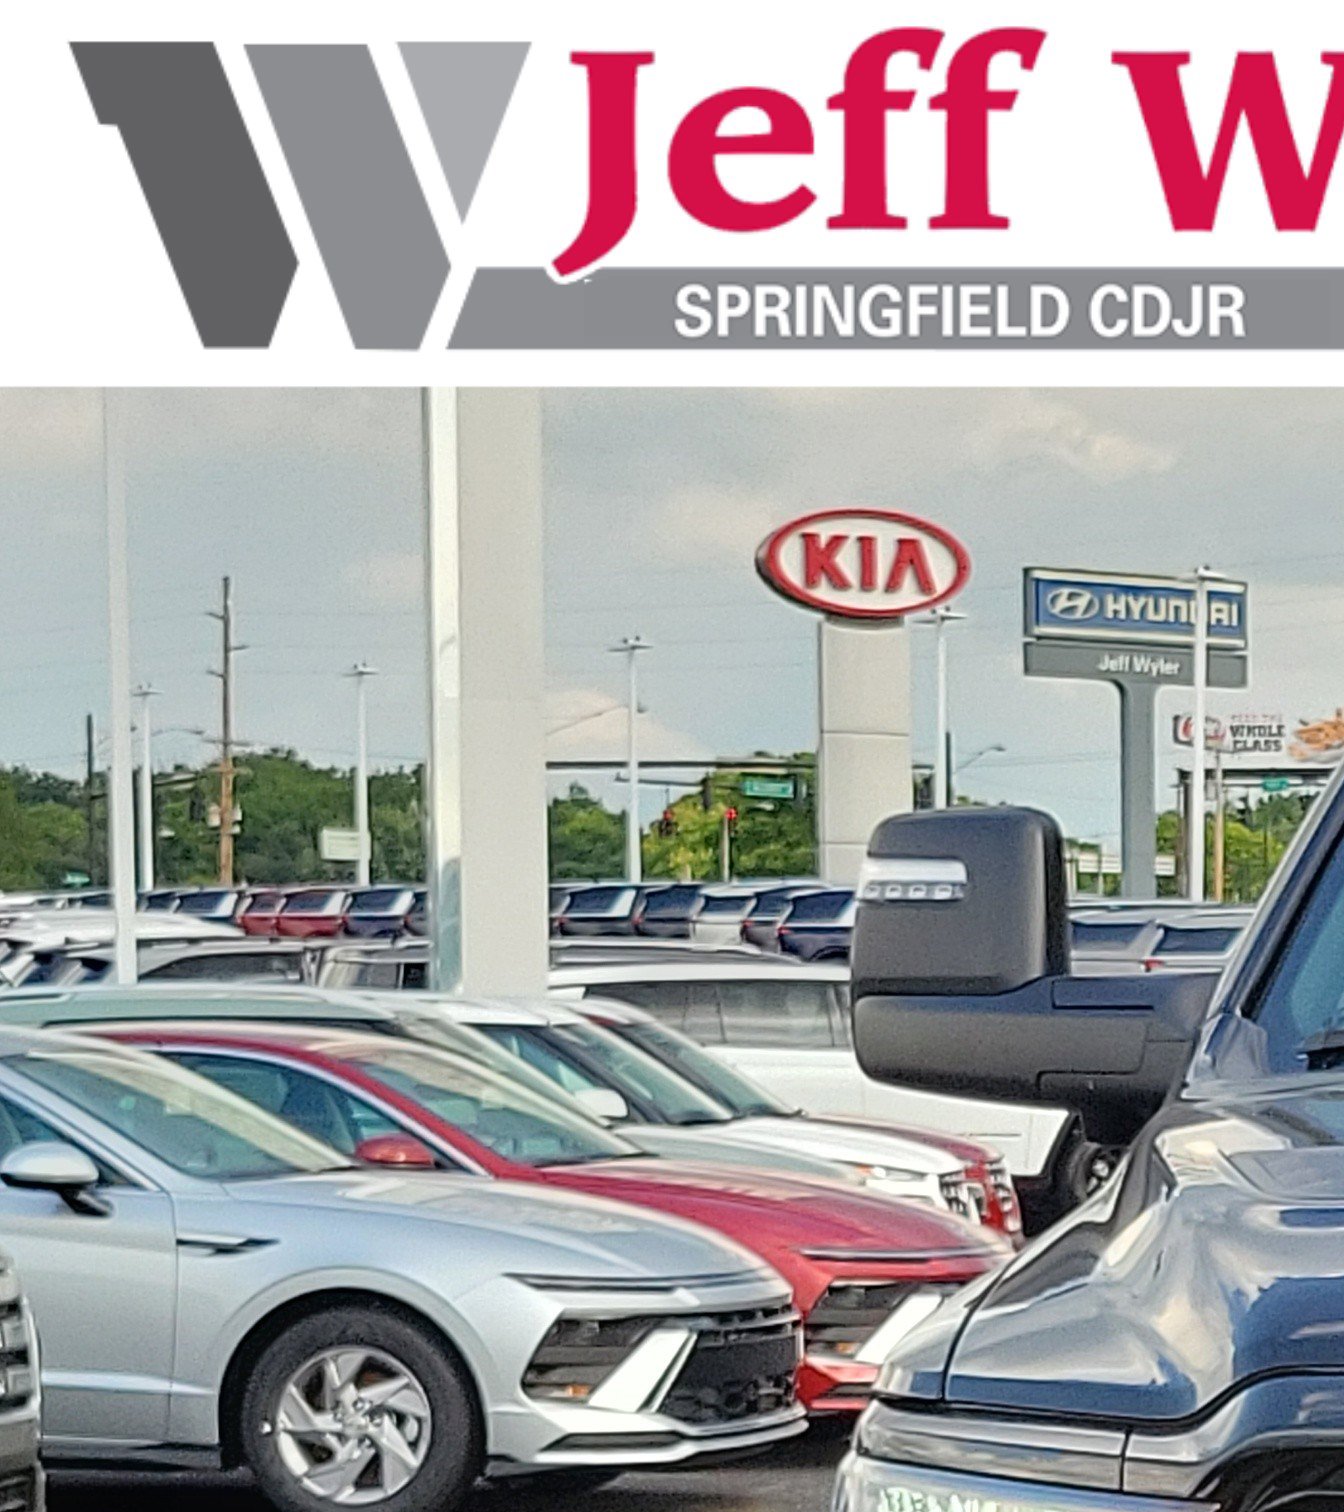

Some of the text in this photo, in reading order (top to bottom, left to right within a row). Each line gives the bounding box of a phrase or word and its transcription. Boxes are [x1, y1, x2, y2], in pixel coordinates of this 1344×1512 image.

[800, 532, 937, 595] KIA
[1098, 653, 1179, 677] Jeff Wyler
